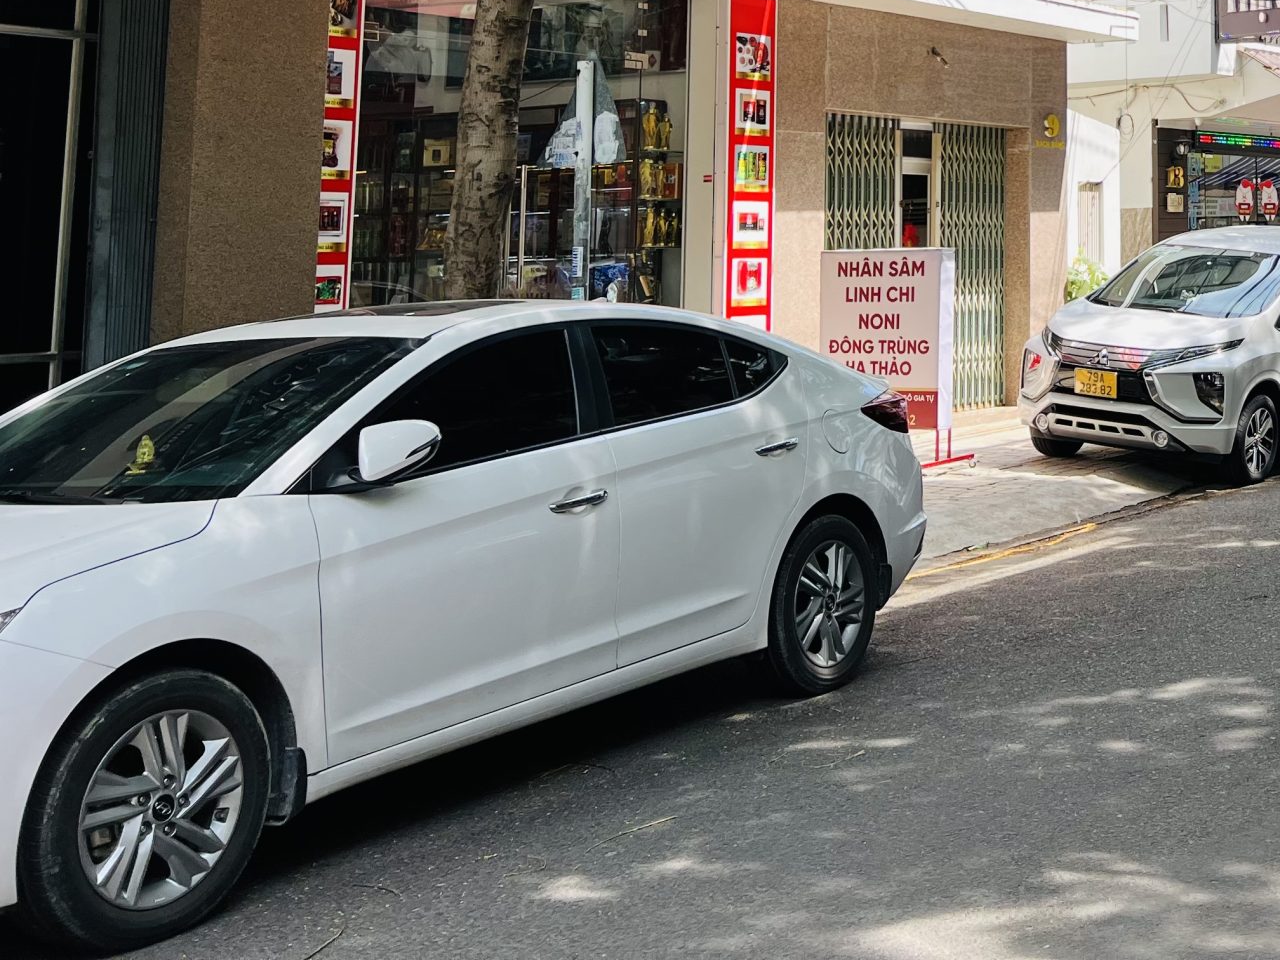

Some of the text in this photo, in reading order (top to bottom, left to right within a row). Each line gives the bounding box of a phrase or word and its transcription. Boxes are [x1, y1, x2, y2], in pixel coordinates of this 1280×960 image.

[837, 257, 925, 278] NHÂN SÂM
[845, 286, 915, 303] LINH CHI
[858, 313, 900, 330] NONI
[829, 336, 930, 355] ĐÔNG TRÙNG
[870, 356, 912, 376] THẢO
[1087, 370, 1105, 384] 79A
